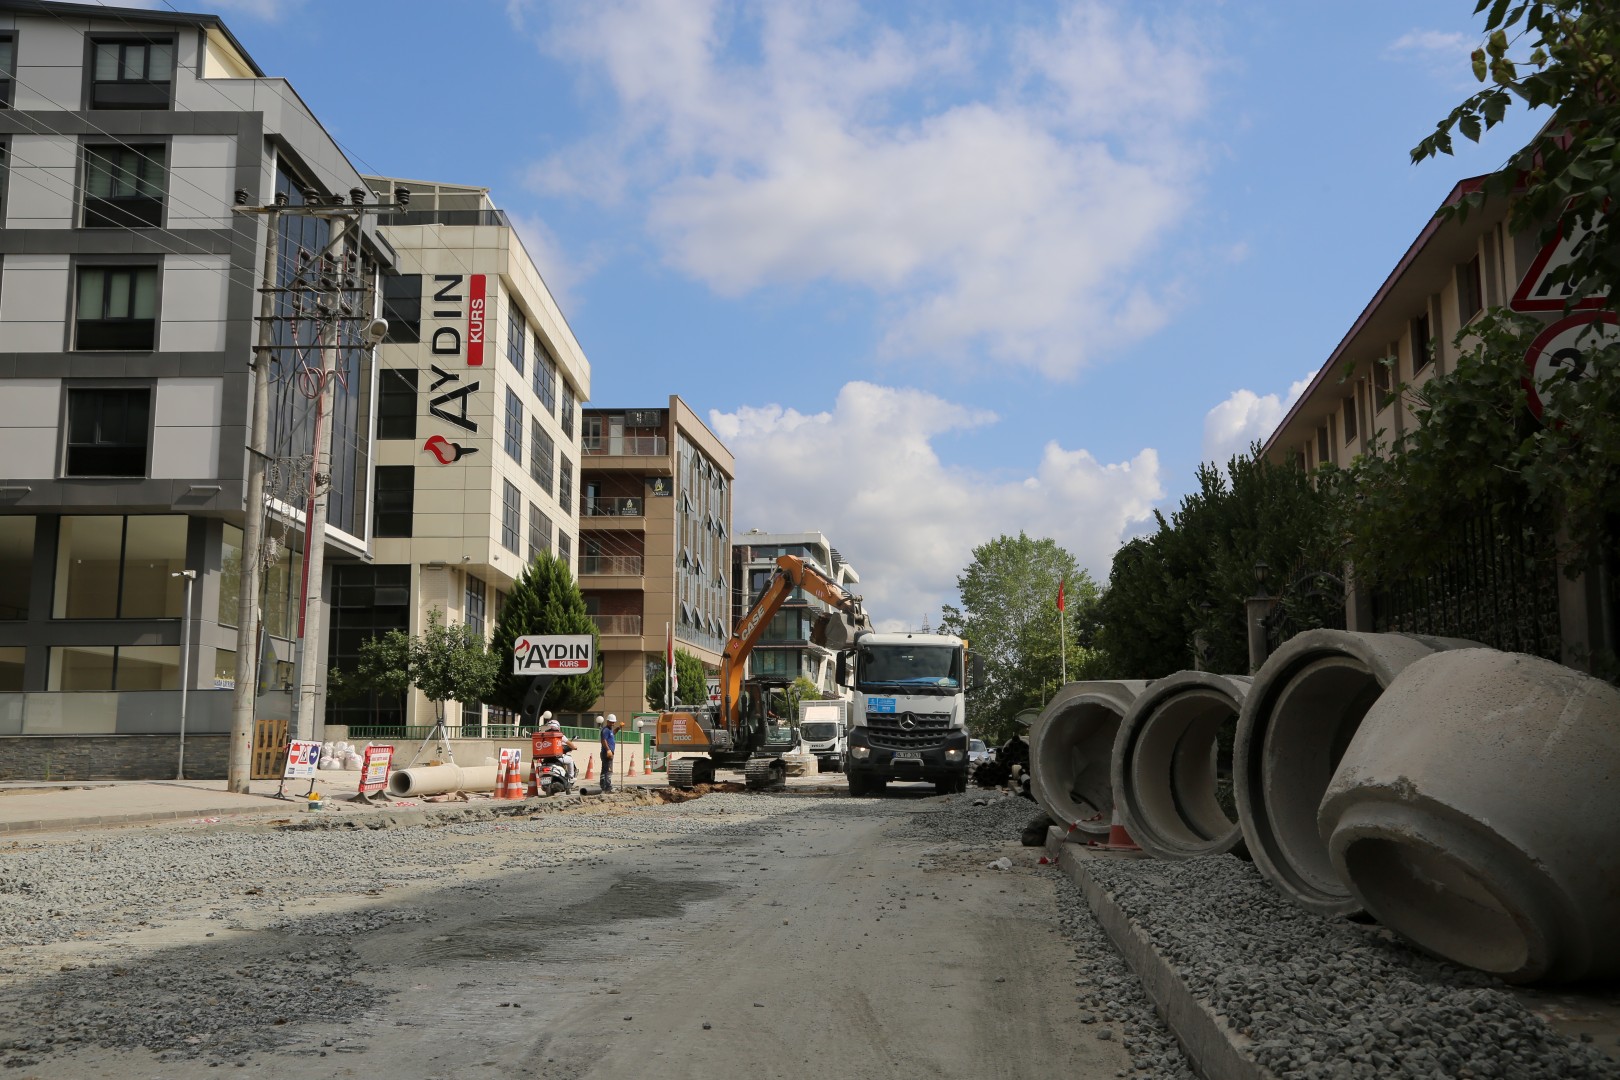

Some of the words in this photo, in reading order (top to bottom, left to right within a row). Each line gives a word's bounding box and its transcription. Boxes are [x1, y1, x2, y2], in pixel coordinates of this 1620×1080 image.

[470, 297, 484, 343] KURS
[429, 274, 480, 433] AYDIN
[741, 604, 765, 641] CASE
[524, 644, 589, 669] AYDIN
[559, 660, 579, 668] KURS
